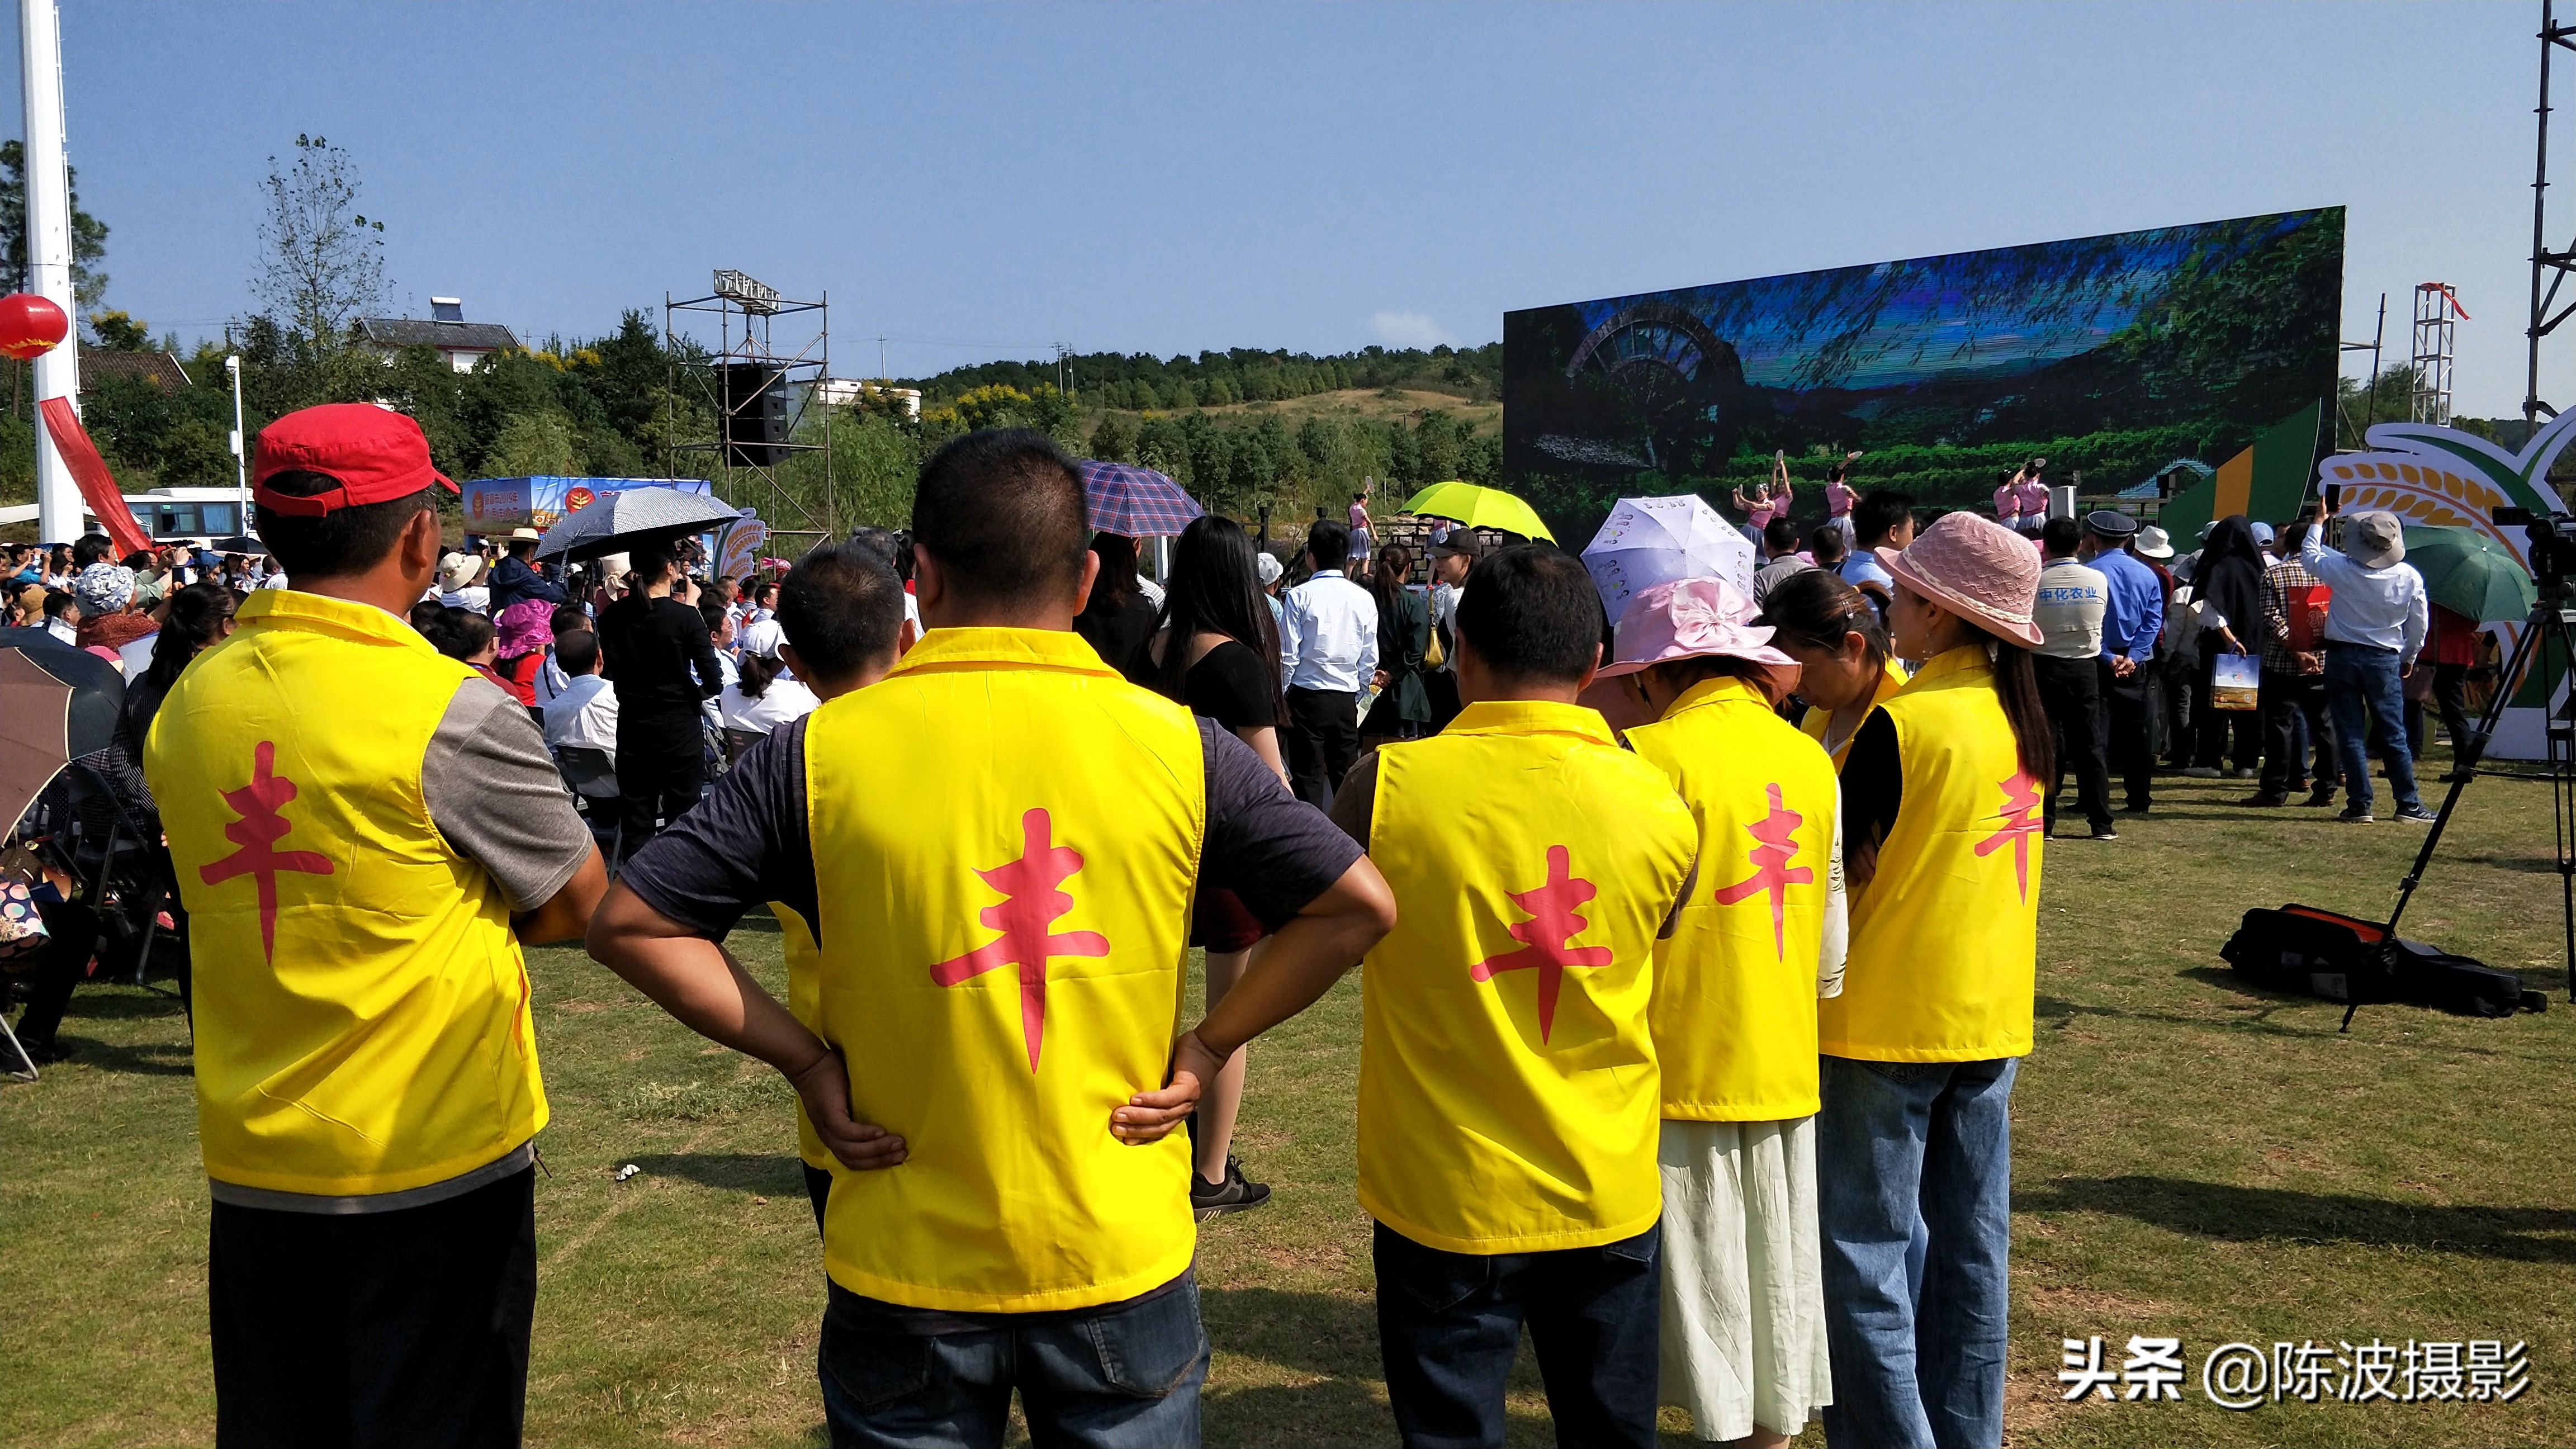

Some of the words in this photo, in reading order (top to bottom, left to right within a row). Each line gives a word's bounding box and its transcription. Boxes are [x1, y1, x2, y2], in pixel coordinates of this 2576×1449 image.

[485, 490, 518, 505] 宜昌市2019年
[2039, 586, 2096, 601] 中化农业
[200, 741, 334, 967] 丰
[1715, 783, 1813, 963] 丰
[1974, 749, 2044, 907] 丰
[930, 808, 1110, 1075] 丰
[1471, 845, 1613, 1046] 丰
